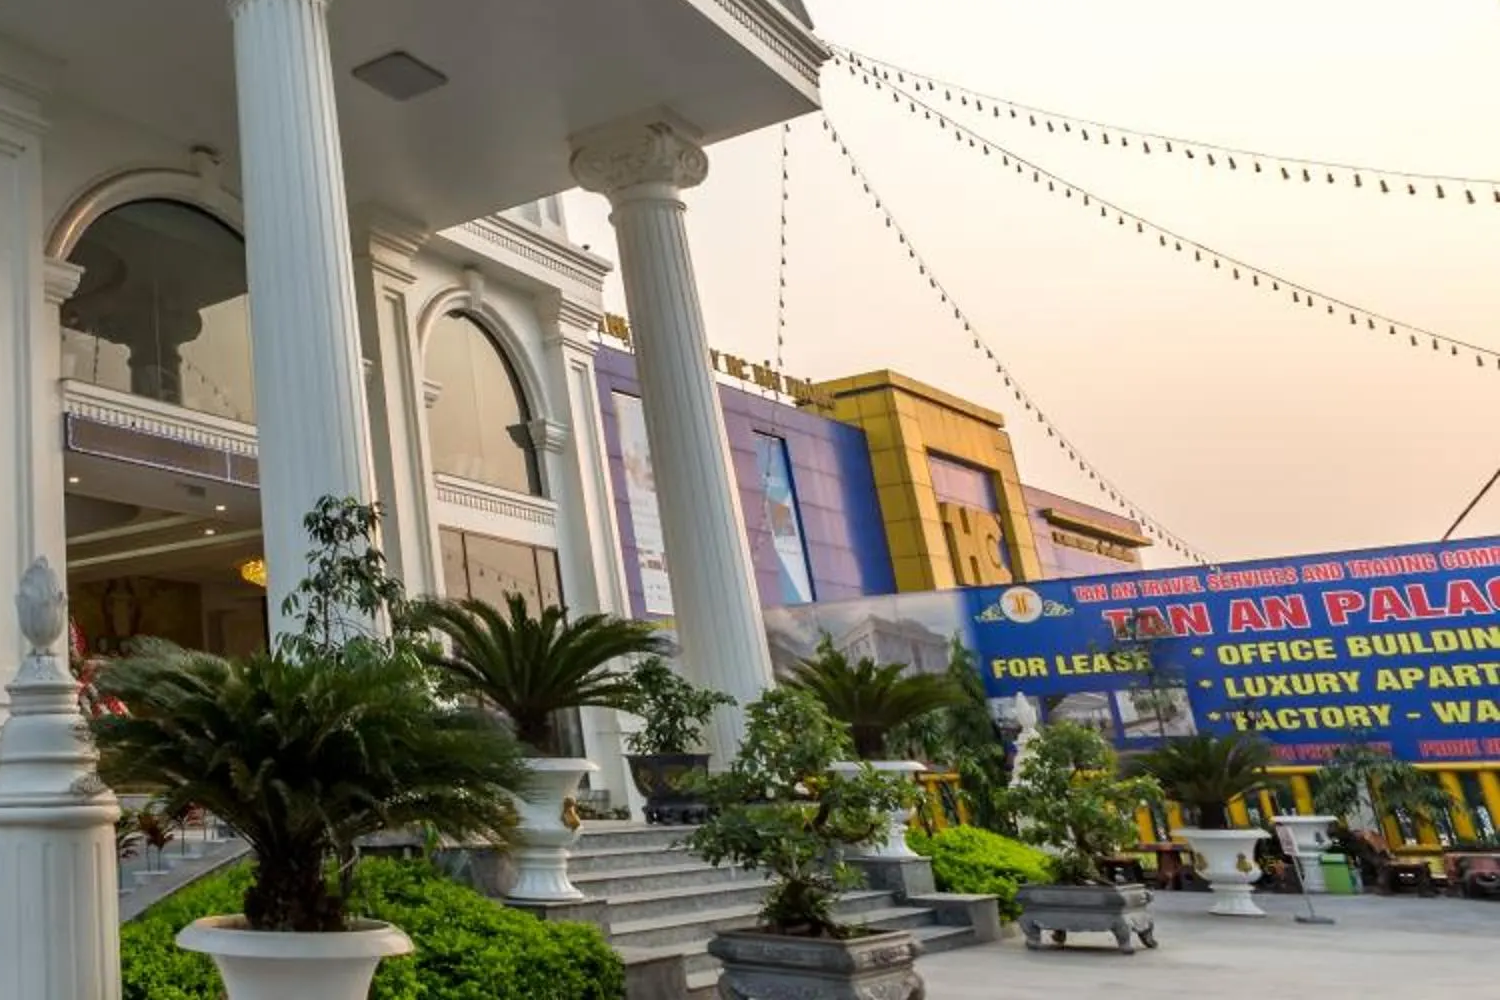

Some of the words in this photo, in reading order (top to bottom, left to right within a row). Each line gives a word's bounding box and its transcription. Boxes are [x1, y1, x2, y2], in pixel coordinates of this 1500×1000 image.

[1207, 565, 1299, 592] SERVICES
[1302, 563, 1344, 583] AND
[1102, 602, 1213, 641] TAN
[1228, 593, 1311, 633] AN
[1217, 638, 1337, 666] OFFICE
[992, 656, 1048, 679] FOR
[1224, 671, 1360, 699] LUXURY
[1377, 662, 1500, 692] APART
[1232, 704, 1391, 731] FACTORY
[1431, 699, 1500, 723] WA
